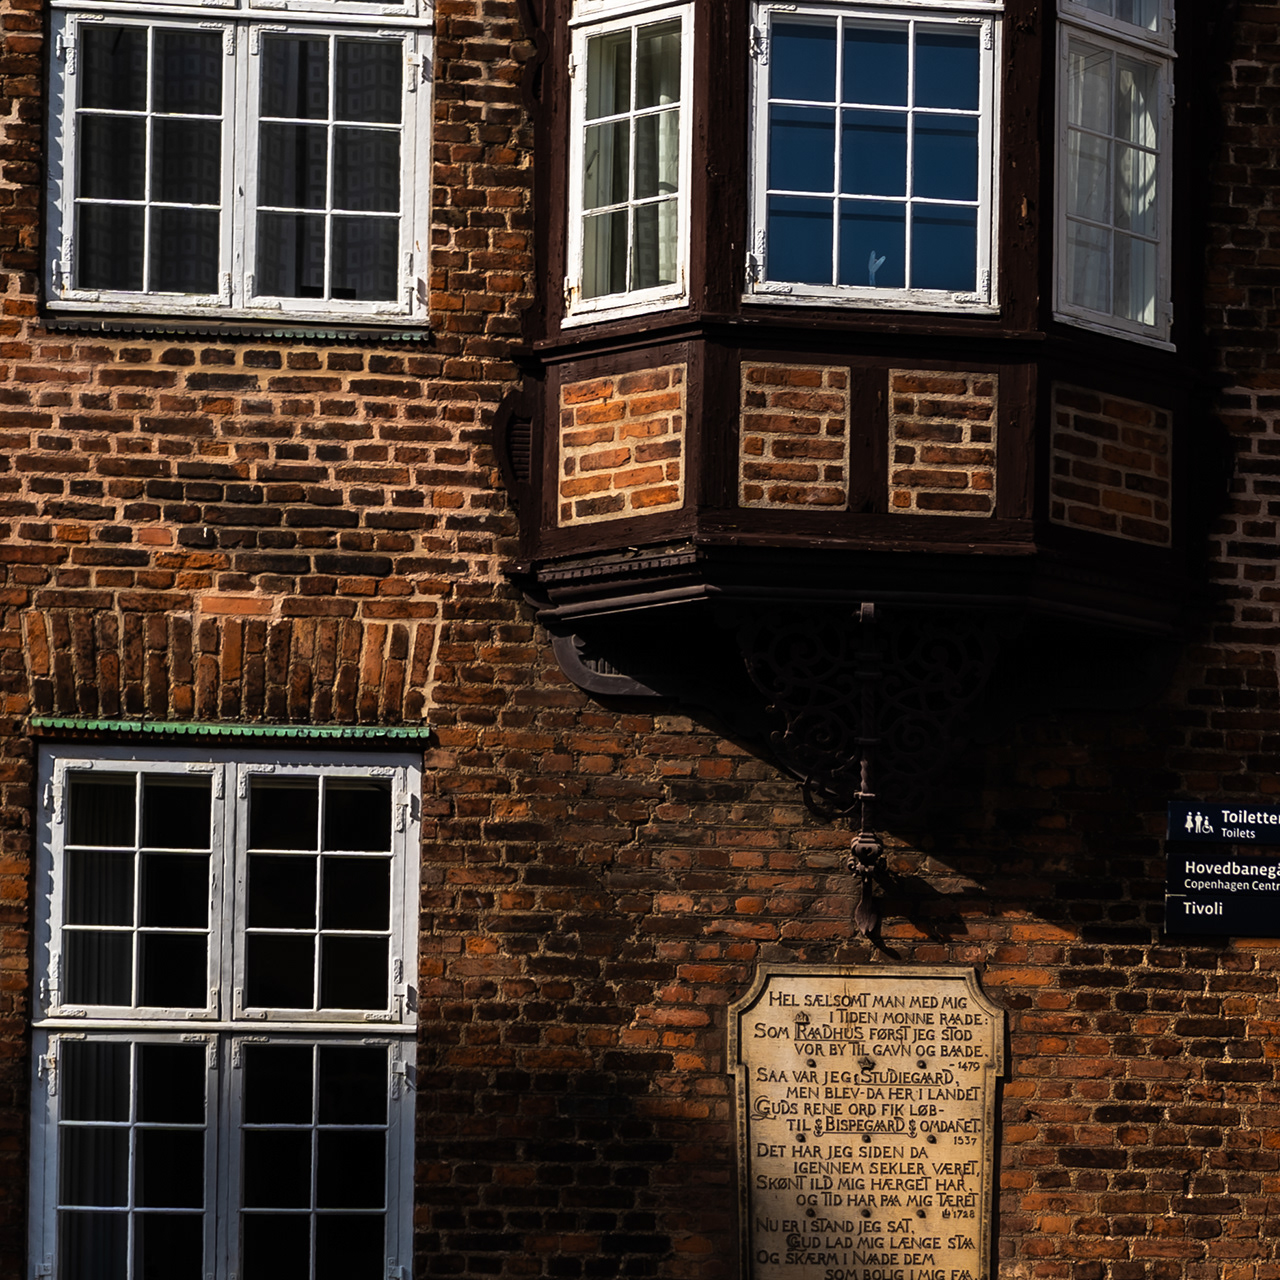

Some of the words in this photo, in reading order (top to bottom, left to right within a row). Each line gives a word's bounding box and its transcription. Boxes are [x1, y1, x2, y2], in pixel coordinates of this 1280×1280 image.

[1221, 828, 1256, 839] Toilets
[1184, 879, 1250, 892] Copenhagen
[1184, 901, 1223, 916] Tivoli
[769, 991, 799, 1007] HEL
[805, 993, 870, 1007] SÆLSOMT
[872, 996, 905, 1008] MAN
[909, 996, 938, 1008] MED
[941, 996, 967, 1009] MIG
[830, 1012, 833, 1022] I
[837, 1009, 878, 1024] TIDEN
[883, 1013, 934, 1025] MONNE
[754, 1023, 789, 1038] SOM
[869, 1026, 910, 1041] FØRST
[913, 1029, 934, 1043] JEG
[794, 1044, 825, 1056] VOR
[830, 1044, 846, 1056] BY
[849, 1041, 869, 1056] TIL
[873, 1044, 911, 1056] GAVN
[916, 1045, 935, 1056] OG
[756, 1068, 787, 1083] SAA
[792, 1071, 818, 1084] VAR
[822, 1071, 851, 1085] JEG
[786, 1087, 819, 1099] MEN
[889, 1088, 915, 1101] HER
[919, 1088, 922, 1100] I
[928, 1086, 980, 1100] LANDET
[751, 1095, 797, 1120] GUDS
[804, 1103, 842, 1116] RENE
[848, 1104, 876, 1117] ORD
[882, 1104, 904, 1116] FIK
[787, 1119, 811, 1131] TIL
[826, 1117, 905, 1132] BISPEGAARD
[954, 1136, 976, 1146] 1537
[757, 1143, 786, 1157] DET
[792, 1146, 823, 1158] HAR
[825, 1147, 852, 1160] JEG
[859, 1146, 903, 1158] SIDEN
[910, 1147, 928, 1158] DA
[794, 1162, 863, 1175] IGENNEM
[869, 1162, 926, 1175] SEKLER
[756, 1175, 807, 1190] SKØNT
[810, 1175, 833, 1190] ILD
[838, 1178, 864, 1190] MIG
[871, 1177, 931, 1191] HÆRGET
[797, 1194, 817, 1206] OG
[821, 1192, 842, 1206] TID
[848, 1194, 878, 1207] HAR
[881, 1195, 901, 1207] PAA
[907, 1194, 932, 1207] MIG
[934, 1193, 979, 1207] TÆRET
[953, 1210, 975, 1219] 1728
[756, 1217, 778, 1232] NU
[783, 1221, 799, 1232] ER
[803, 1221, 806, 1232] I
[811, 1218, 854, 1233] STAND
[857, 1221, 881, 1235] JEG
[786, 1234, 821, 1251] GUD
[826, 1237, 852, 1249] LAD
[857, 1237, 884, 1249] MIG
[890, 1237, 941, 1249] LÆNGE
[756, 1250, 779, 1264] OG
[785, 1253, 838, 1265] SKÆRM
[844, 1253, 847, 1264] I
[853, 1251, 899, 1265] NAADE
[904, 1253, 934, 1265] DEM
[825, 1270, 858, 1280] SOM
[910, 1270, 913, 1280] I
